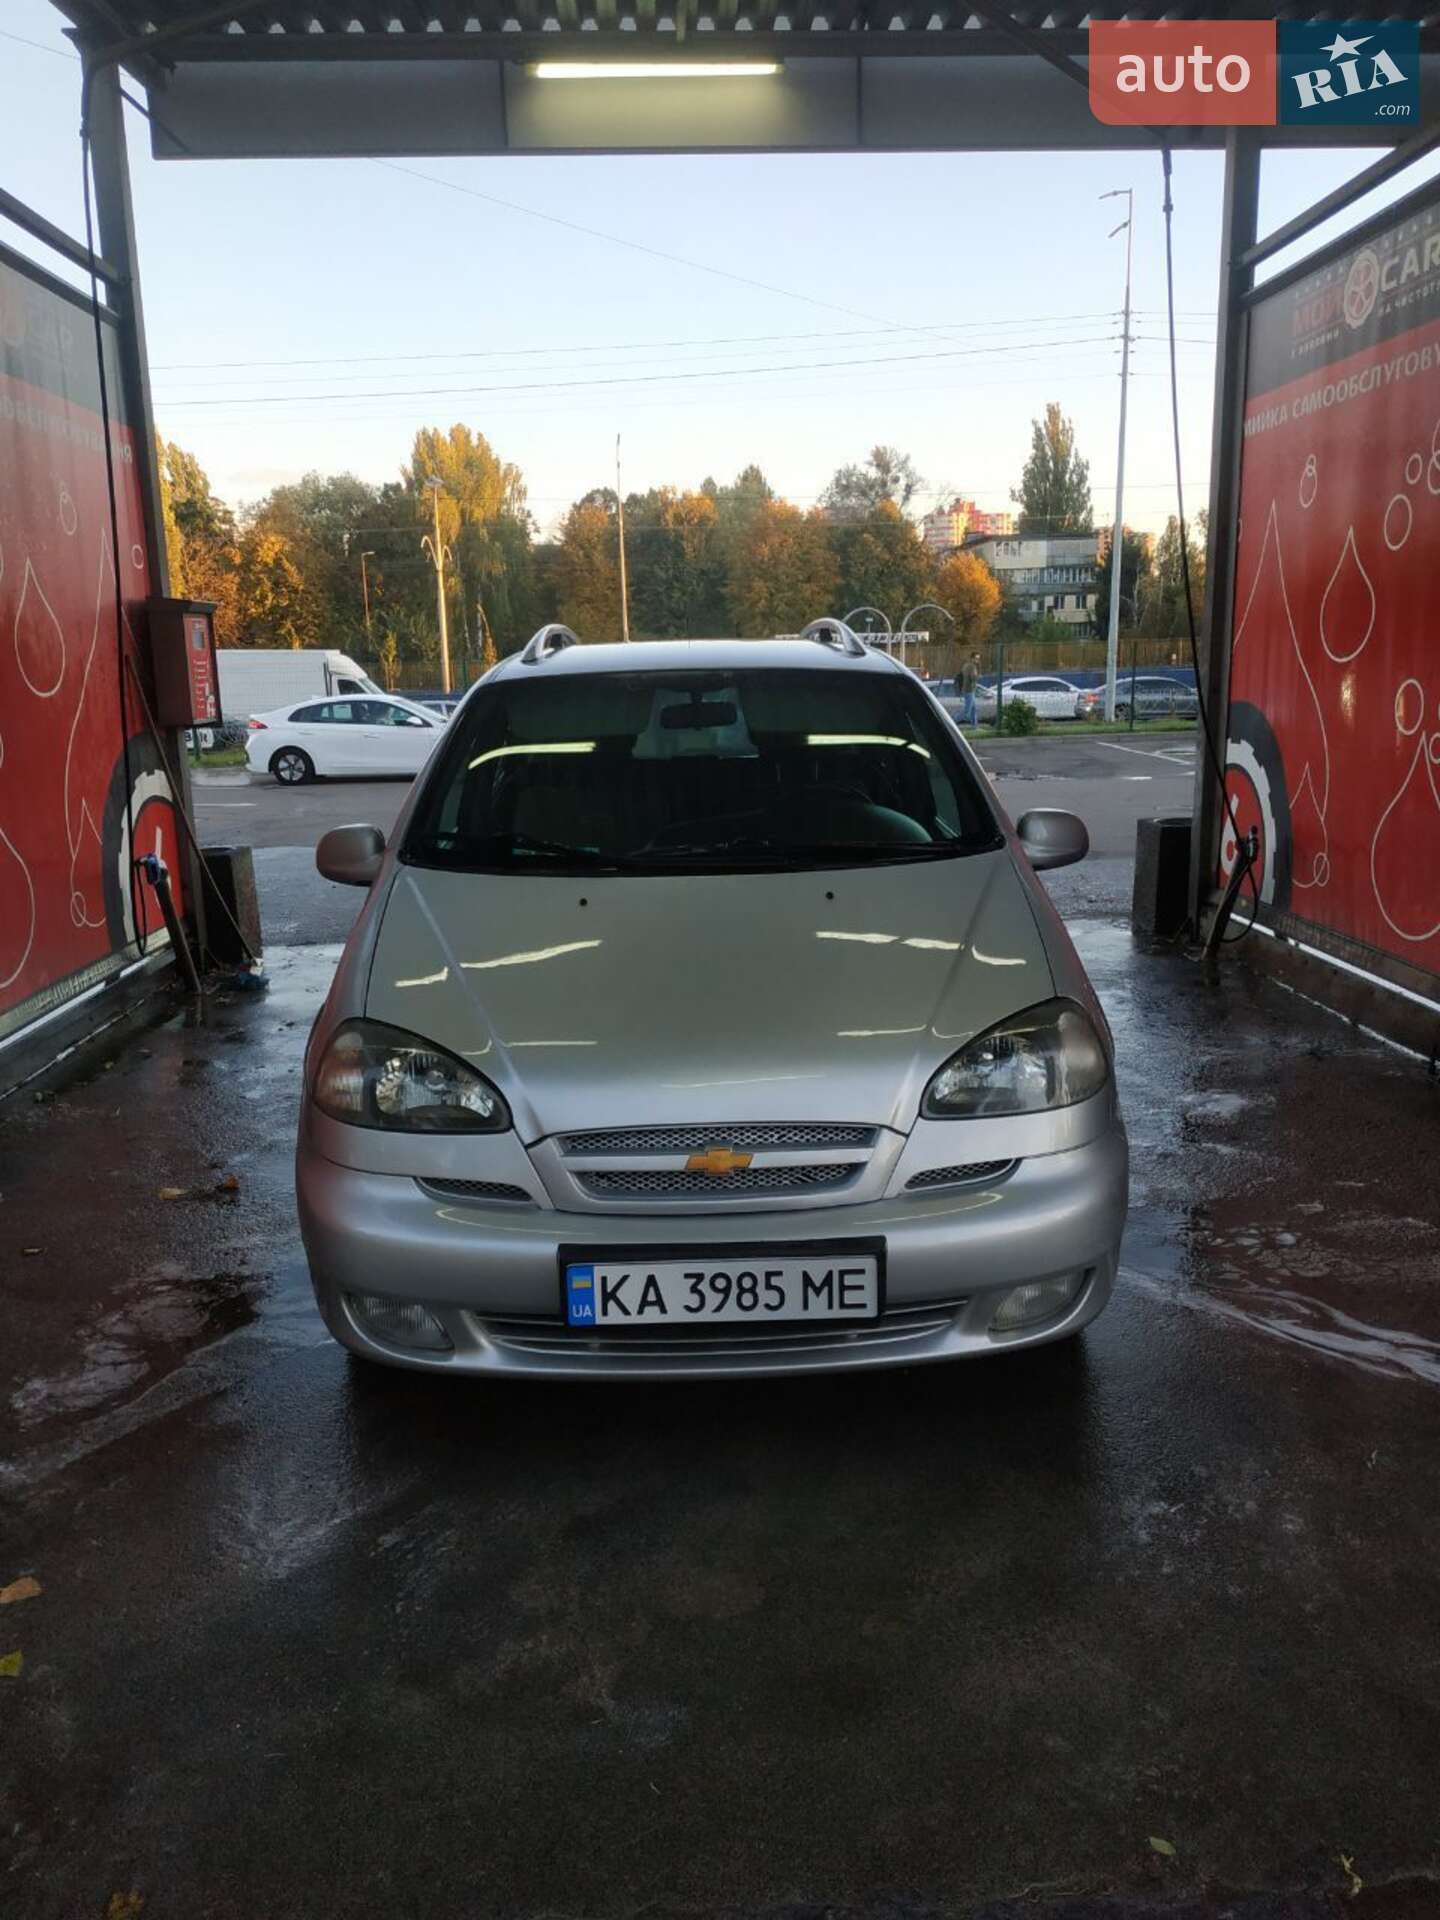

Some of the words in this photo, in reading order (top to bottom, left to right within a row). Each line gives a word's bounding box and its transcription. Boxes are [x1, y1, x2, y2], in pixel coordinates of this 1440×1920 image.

[572, 1304, 593, 1318] UA
[600, 1274, 668, 1317] KA
[682, 1270, 786, 1313] 3985
[802, 1268, 868, 1311] ME
